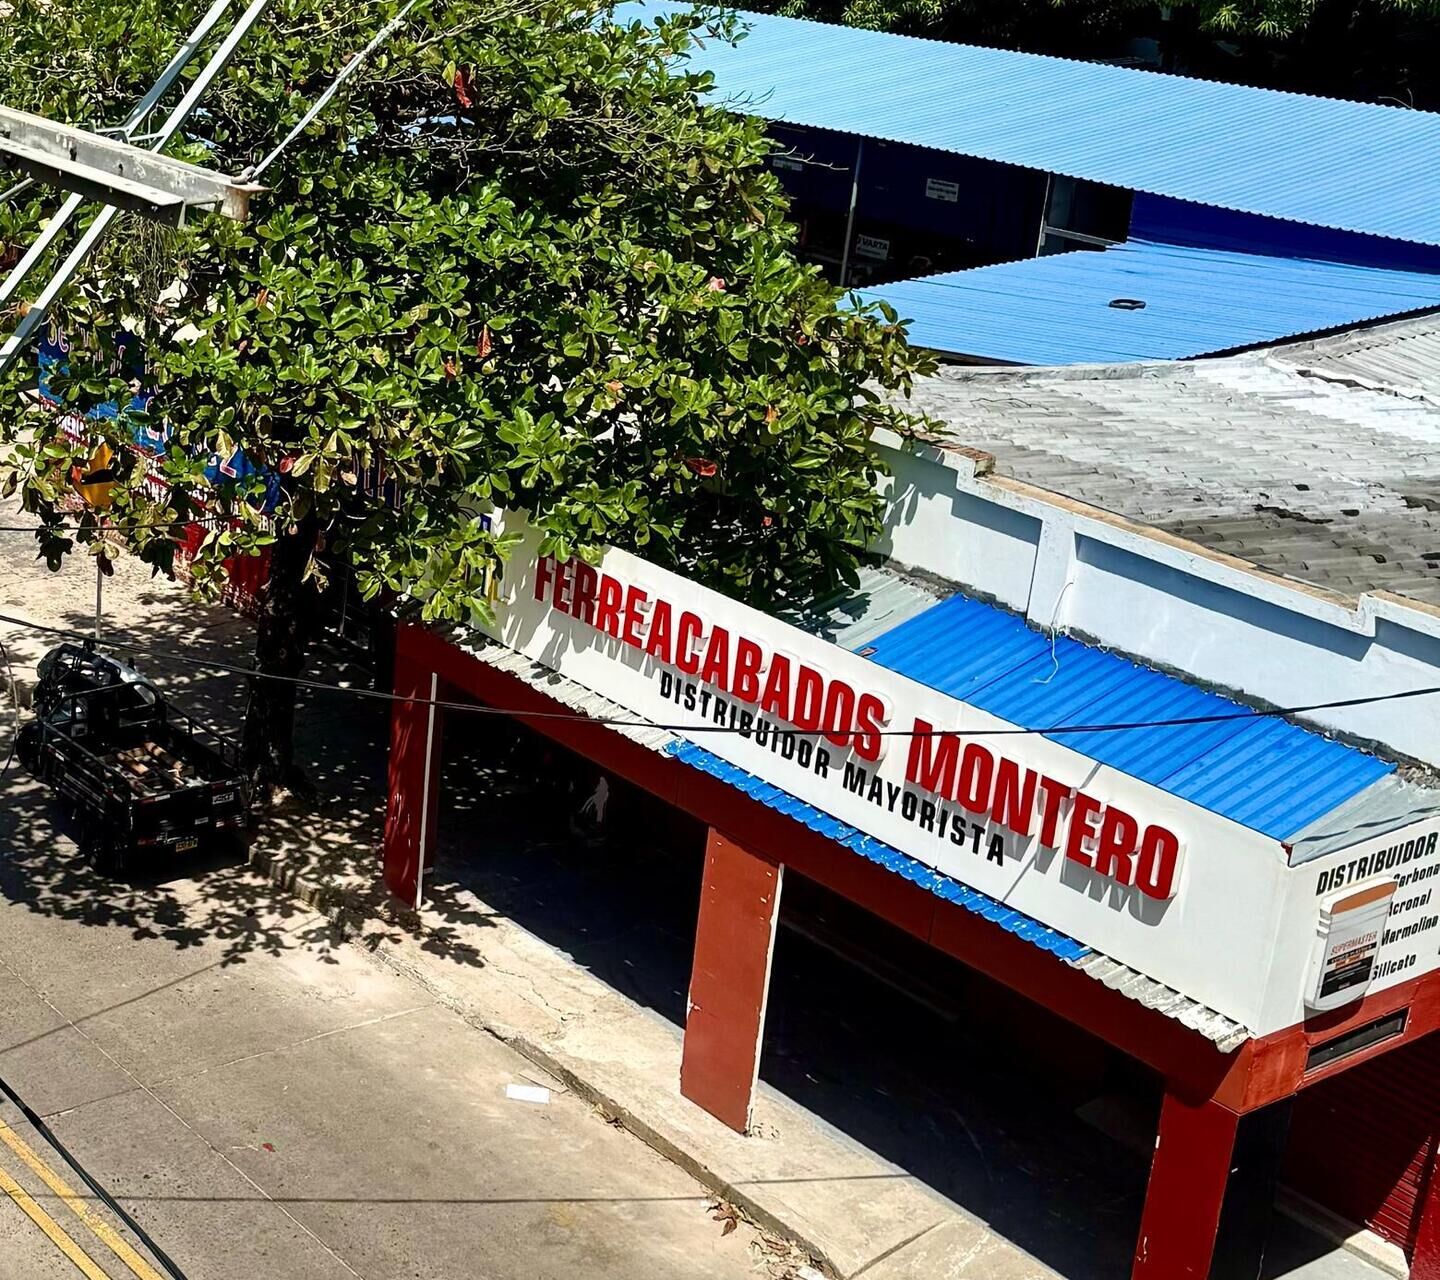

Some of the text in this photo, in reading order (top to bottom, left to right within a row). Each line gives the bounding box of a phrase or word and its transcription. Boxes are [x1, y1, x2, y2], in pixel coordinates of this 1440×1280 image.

[861, 237, 889, 251] VARTA
[534, 554, 1180, 900] FERREACABADOS MONTERO
[660, 670, 1005, 867] DISTRIBUIDOR MAYORISTA
[1315, 831, 1439, 896] DISTRIBUIDOR
